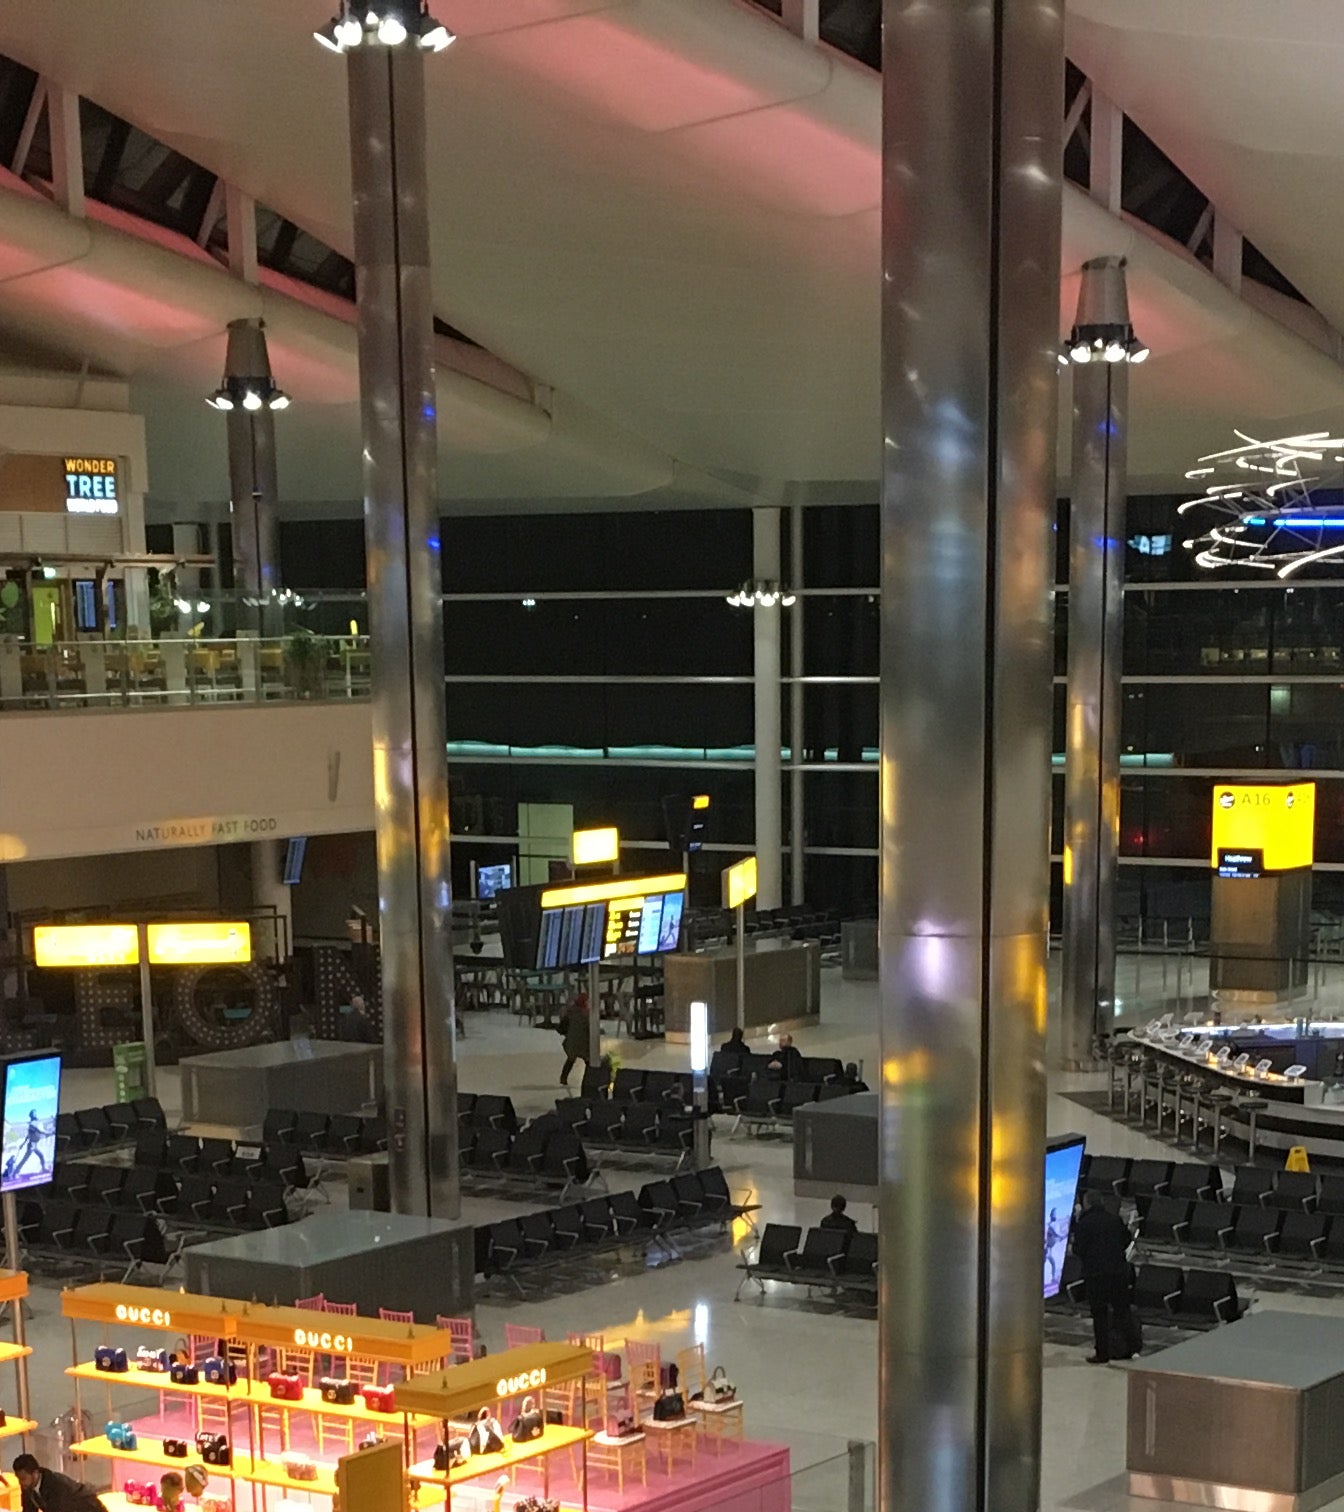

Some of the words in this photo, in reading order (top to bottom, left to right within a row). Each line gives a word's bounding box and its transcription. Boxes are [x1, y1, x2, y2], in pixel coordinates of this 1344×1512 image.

[65, 458, 115, 474] WONDER
[65, 474, 116, 498] TREE
[1241, 792, 1271, 806] A16
[136, 823, 206, 841] NATURALLY
[212, 820, 239, 835] FAST
[244, 817, 278, 832] FOOD
[116, 1304, 171, 1327] GUCCI
[294, 1328, 353, 1353] GUCCI
[496, 1367, 547, 1397] GUCCI
